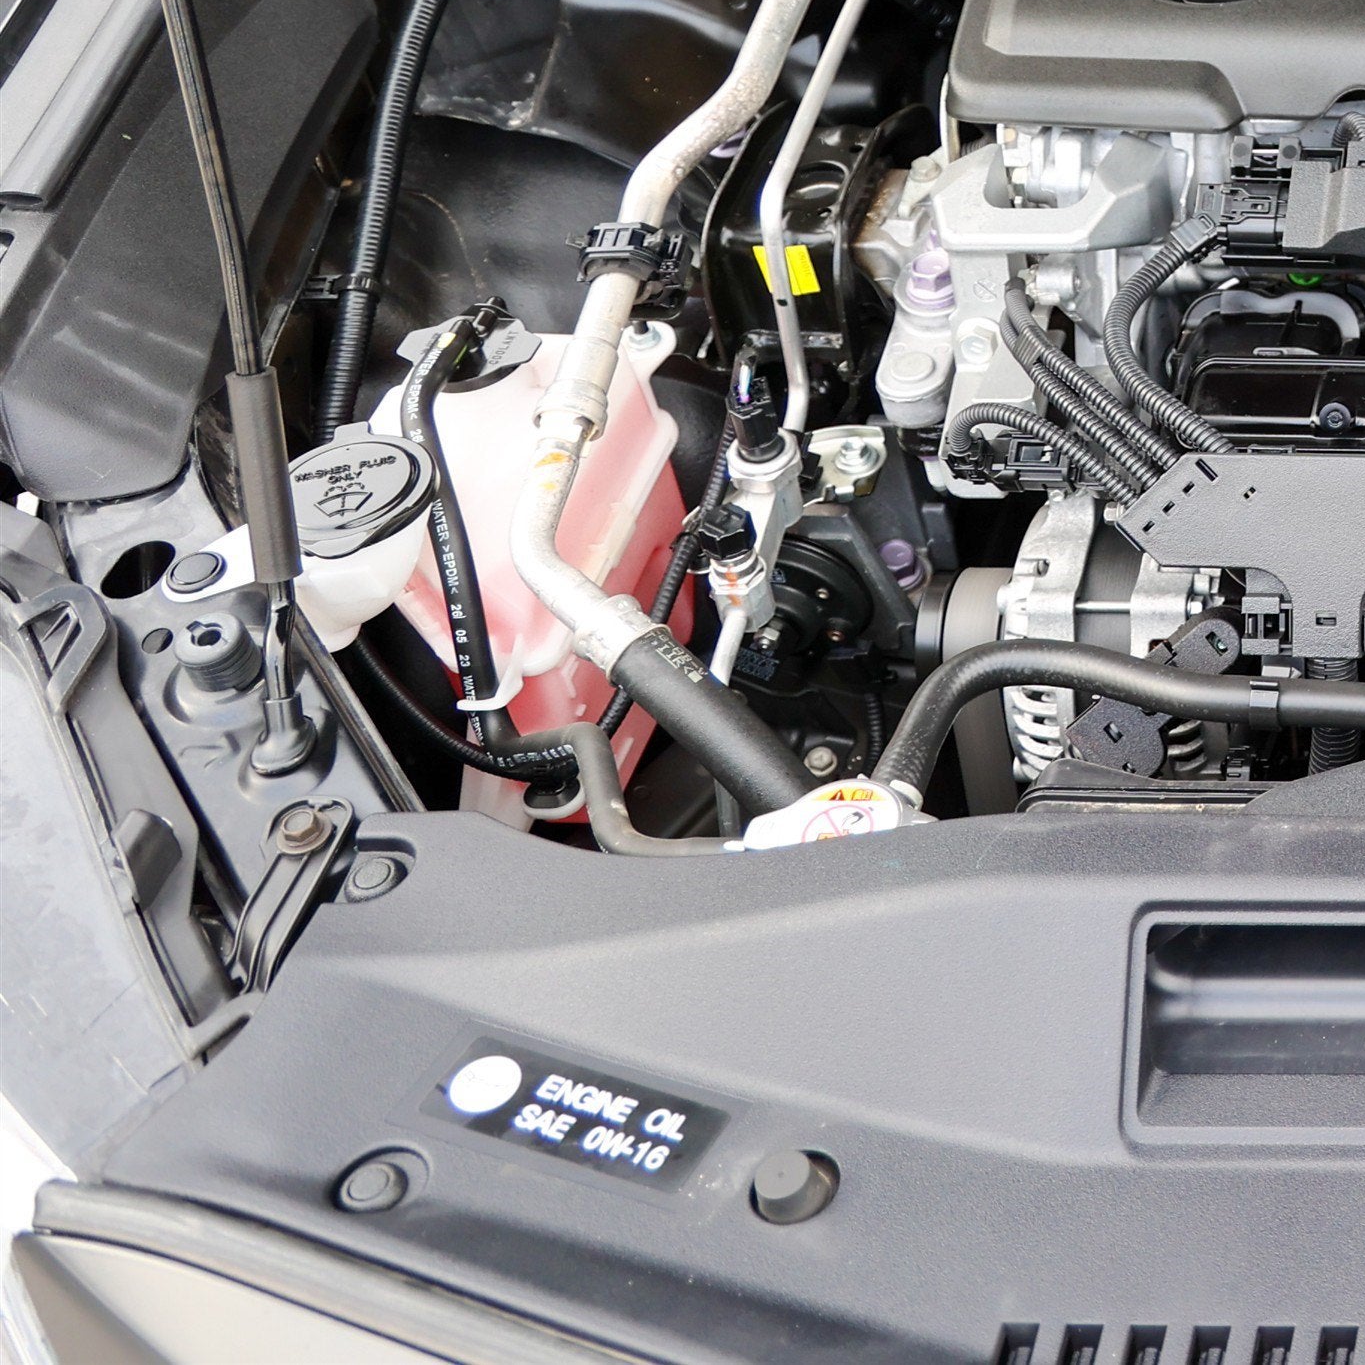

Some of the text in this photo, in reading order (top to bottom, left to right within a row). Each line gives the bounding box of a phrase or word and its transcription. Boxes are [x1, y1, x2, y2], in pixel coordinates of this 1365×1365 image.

[489, 331, 518, 366] COOLANT
[294, 455, 397, 483] WASHER FLUID
[328, 470, 363, 485] ONLY
[431, 498, 450, 543] WATER
[454, 628, 467, 644] 05
[458, 653, 471, 668] 23
[534, 1074, 688, 1142] ENGINE OIL
[514, 1103, 671, 1172] SAE 0W-16
